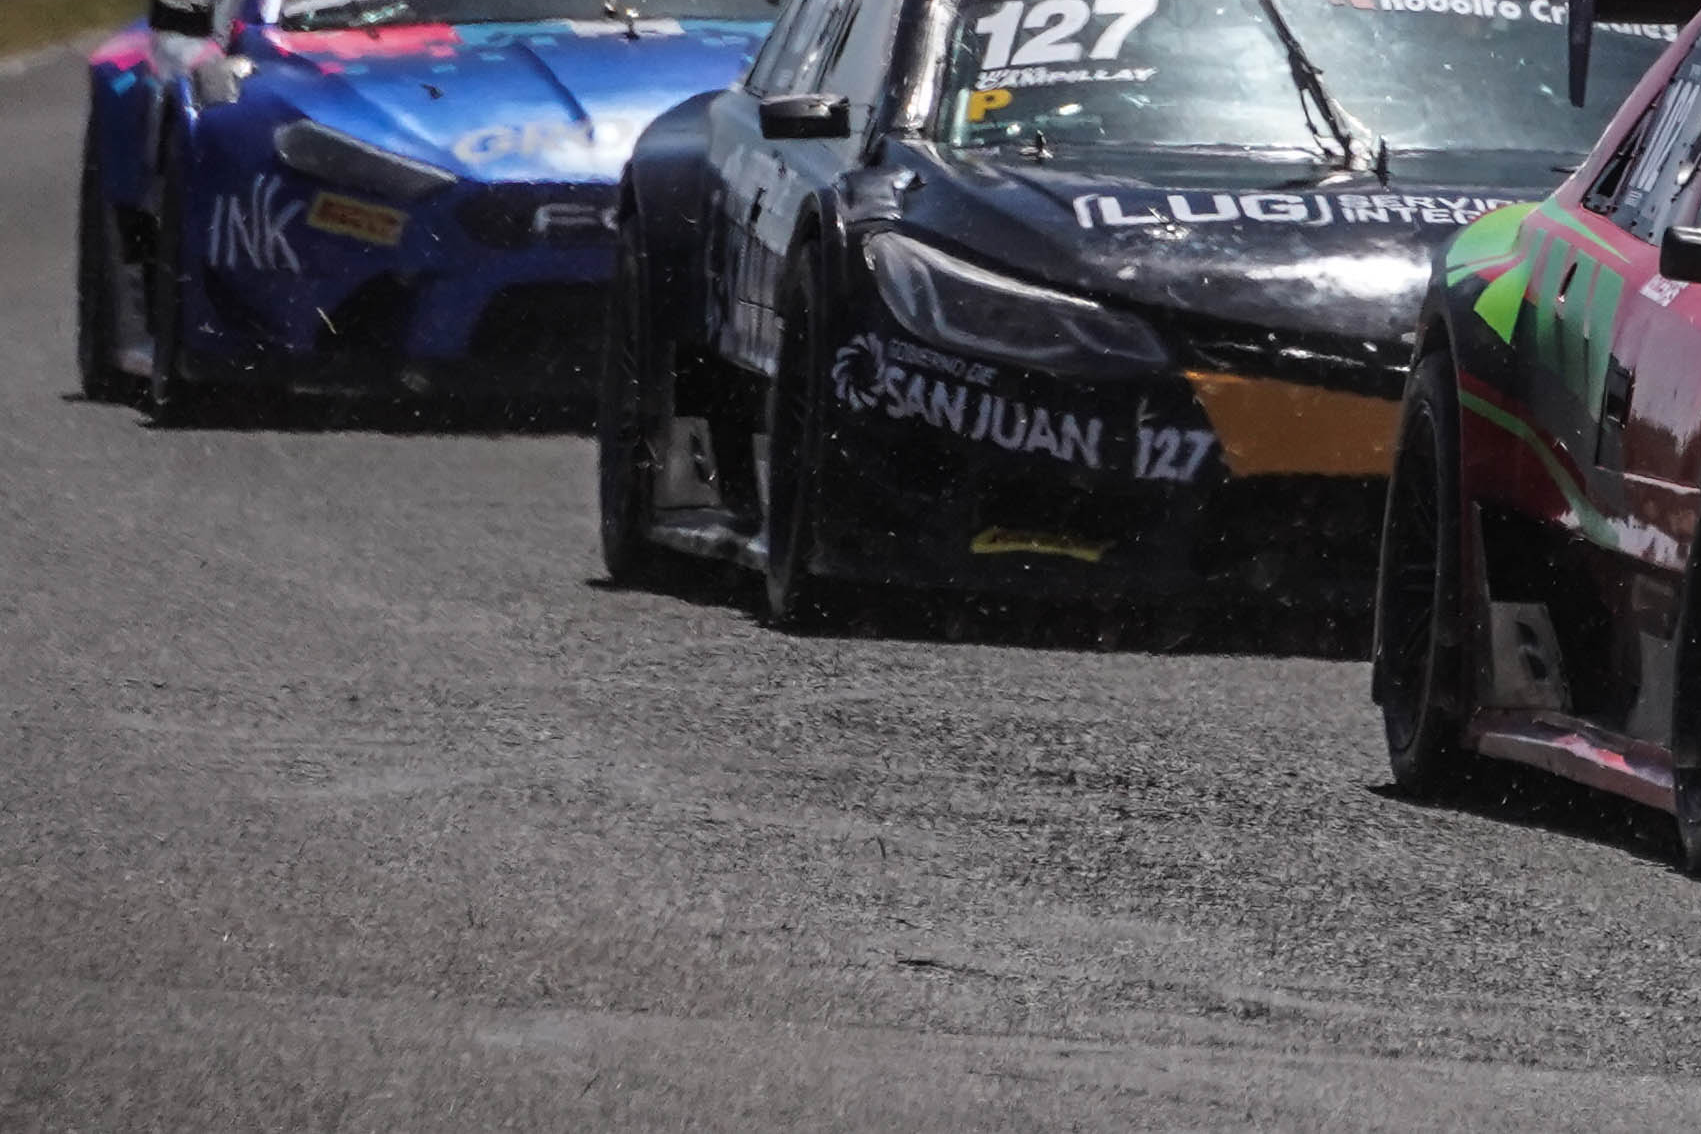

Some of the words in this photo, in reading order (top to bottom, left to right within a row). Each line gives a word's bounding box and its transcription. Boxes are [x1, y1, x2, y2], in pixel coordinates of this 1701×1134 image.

[967, 89, 1013, 123] P
[884, 365, 969, 435] SAN
[969, 392, 1104, 468] JUAN
[1134, 424, 1217, 482] 127
